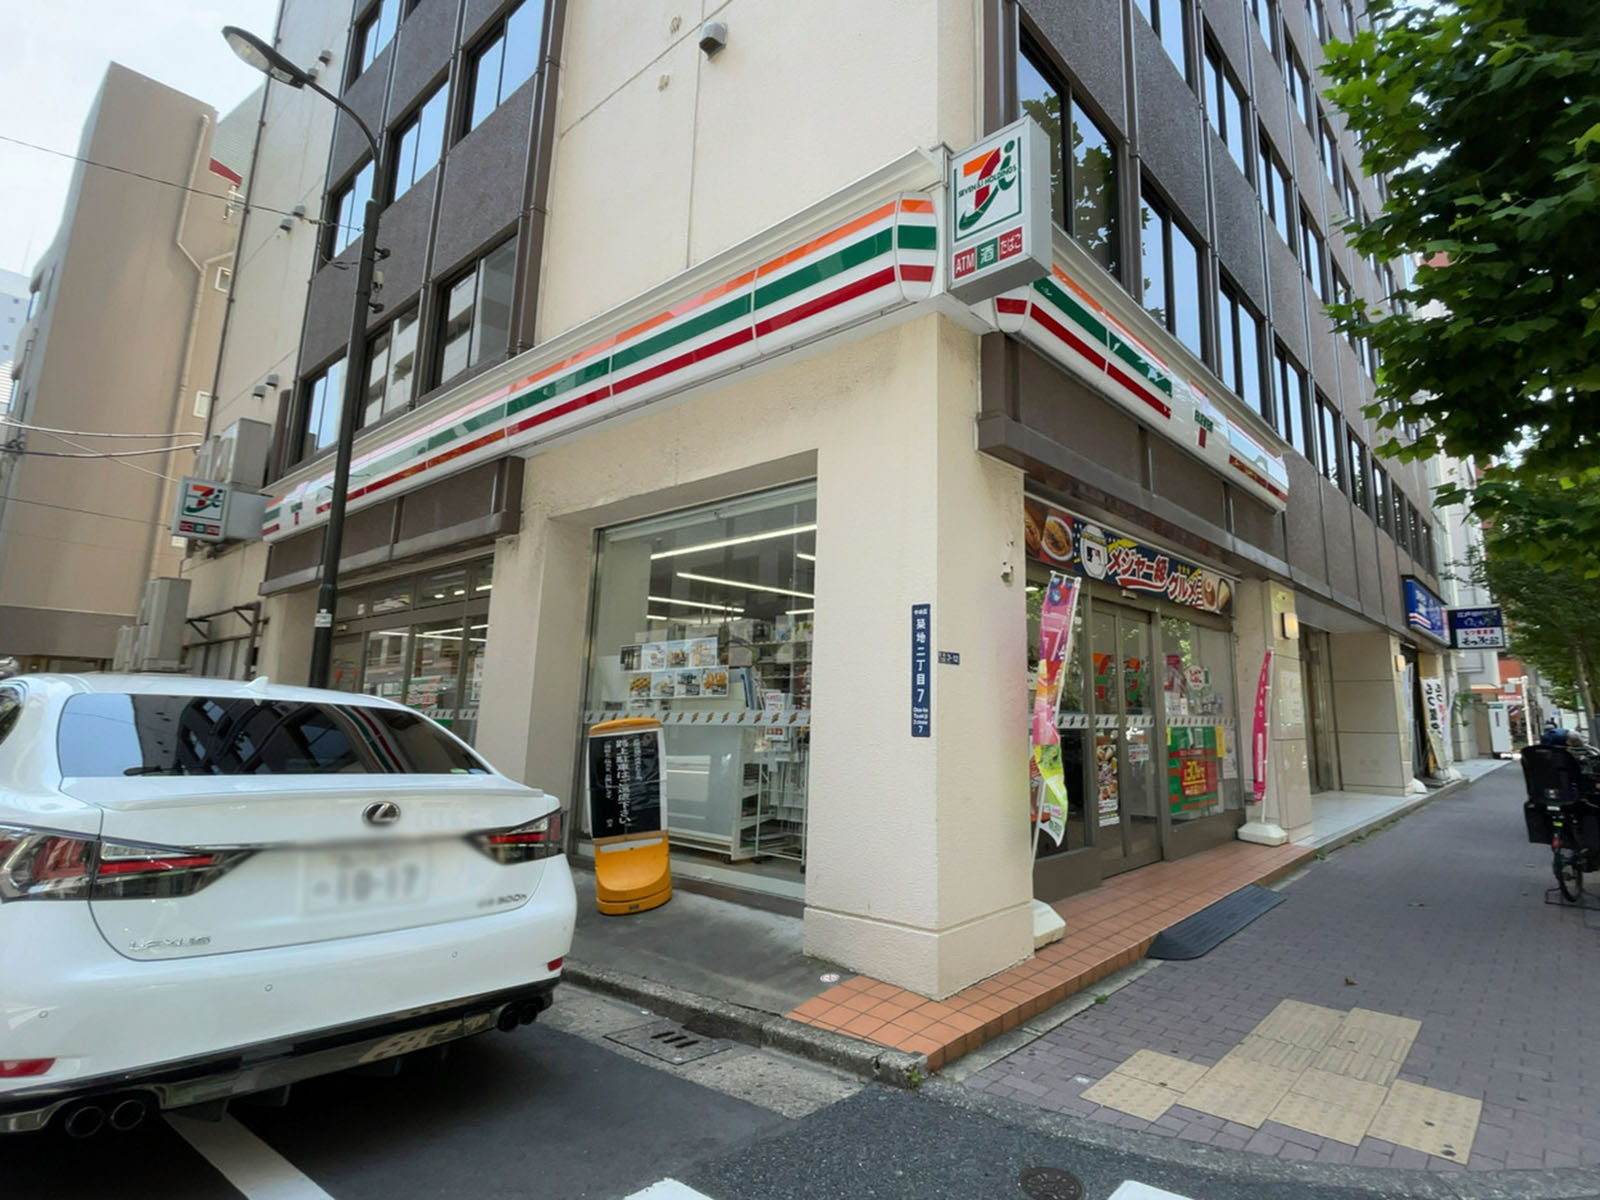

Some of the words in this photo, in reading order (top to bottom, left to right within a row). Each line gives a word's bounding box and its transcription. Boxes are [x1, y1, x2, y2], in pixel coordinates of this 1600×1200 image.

[1000, 233, 1021, 254] たばこ
[955, 254, 975, 274] ATM
[980, 244, 994, 264] 酒
[918, 725, 923, 733] 7
